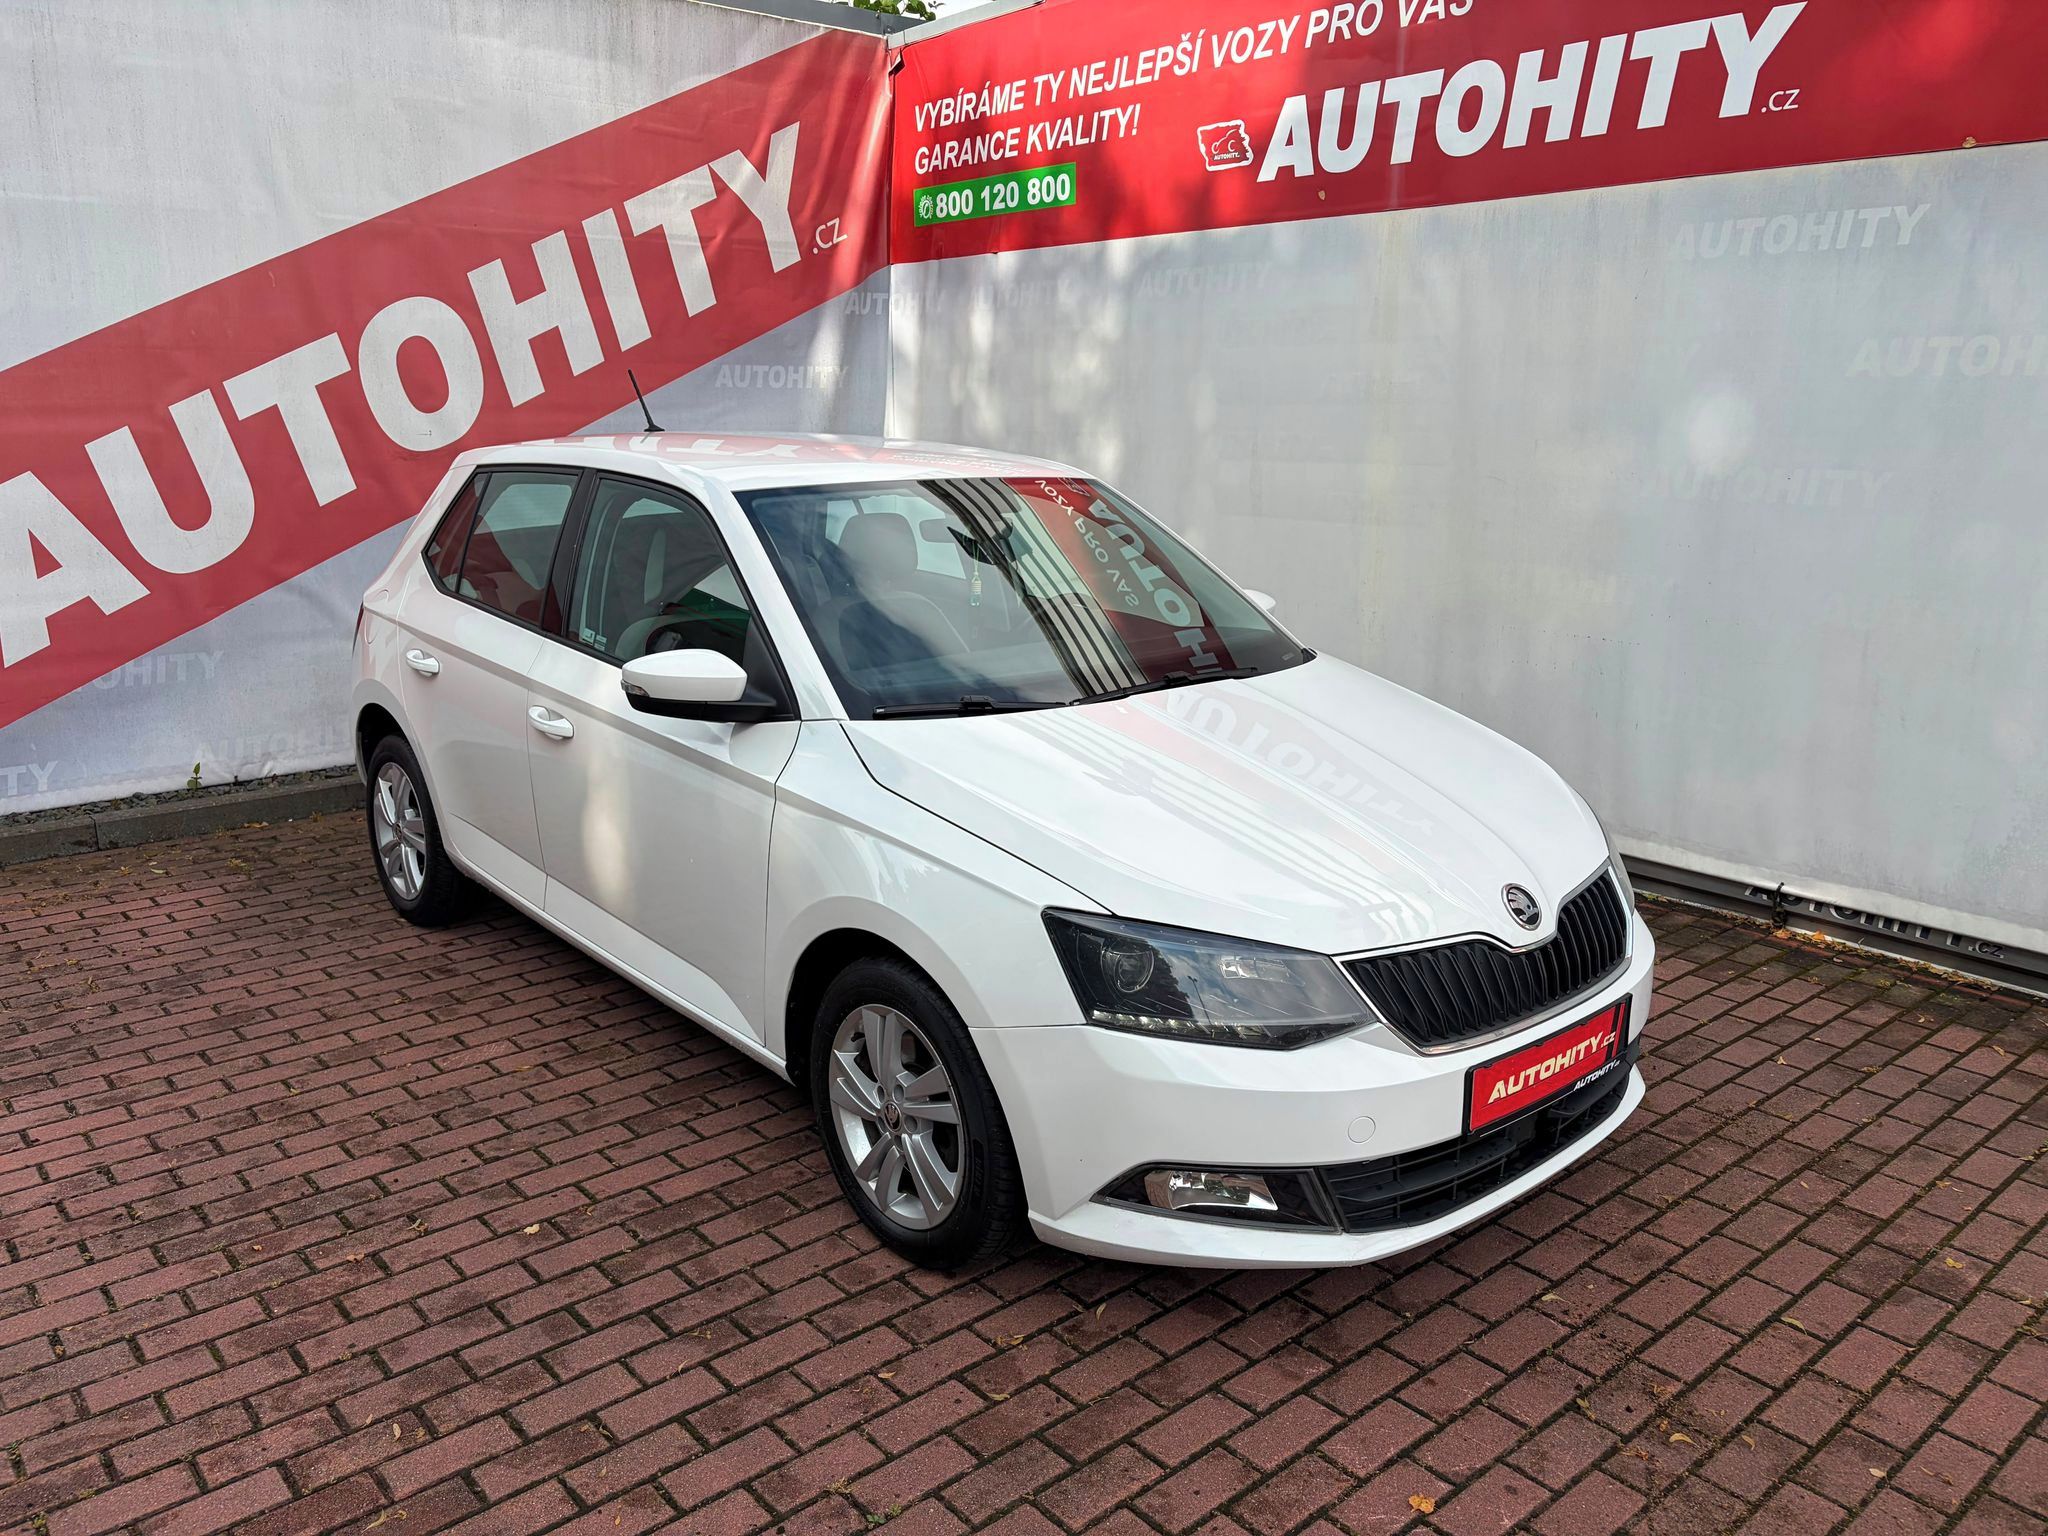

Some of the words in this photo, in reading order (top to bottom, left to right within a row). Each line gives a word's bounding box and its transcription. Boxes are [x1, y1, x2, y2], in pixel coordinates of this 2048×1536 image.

[914, 80, 1027, 132] VYBÍRÁME
[1033, 71, 1065, 106] TY
[1069, 28, 1206, 99] NEJLEPŠÍ
[1211, 15, 1301, 68] VOZY
[1304, 0, 1384, 49] PRO
[914, 127, 1021, 175] GARANCE
[1026, 103, 1142, 154] KVALITY!
[936, 189, 973, 218] 800
[980, 181, 1020, 212] 120
[1027, 173, 1071, 205] 800
[1674, 204, 1931, 260] AUTOHITY
[715, 364, 849, 389] AUTOHITY
